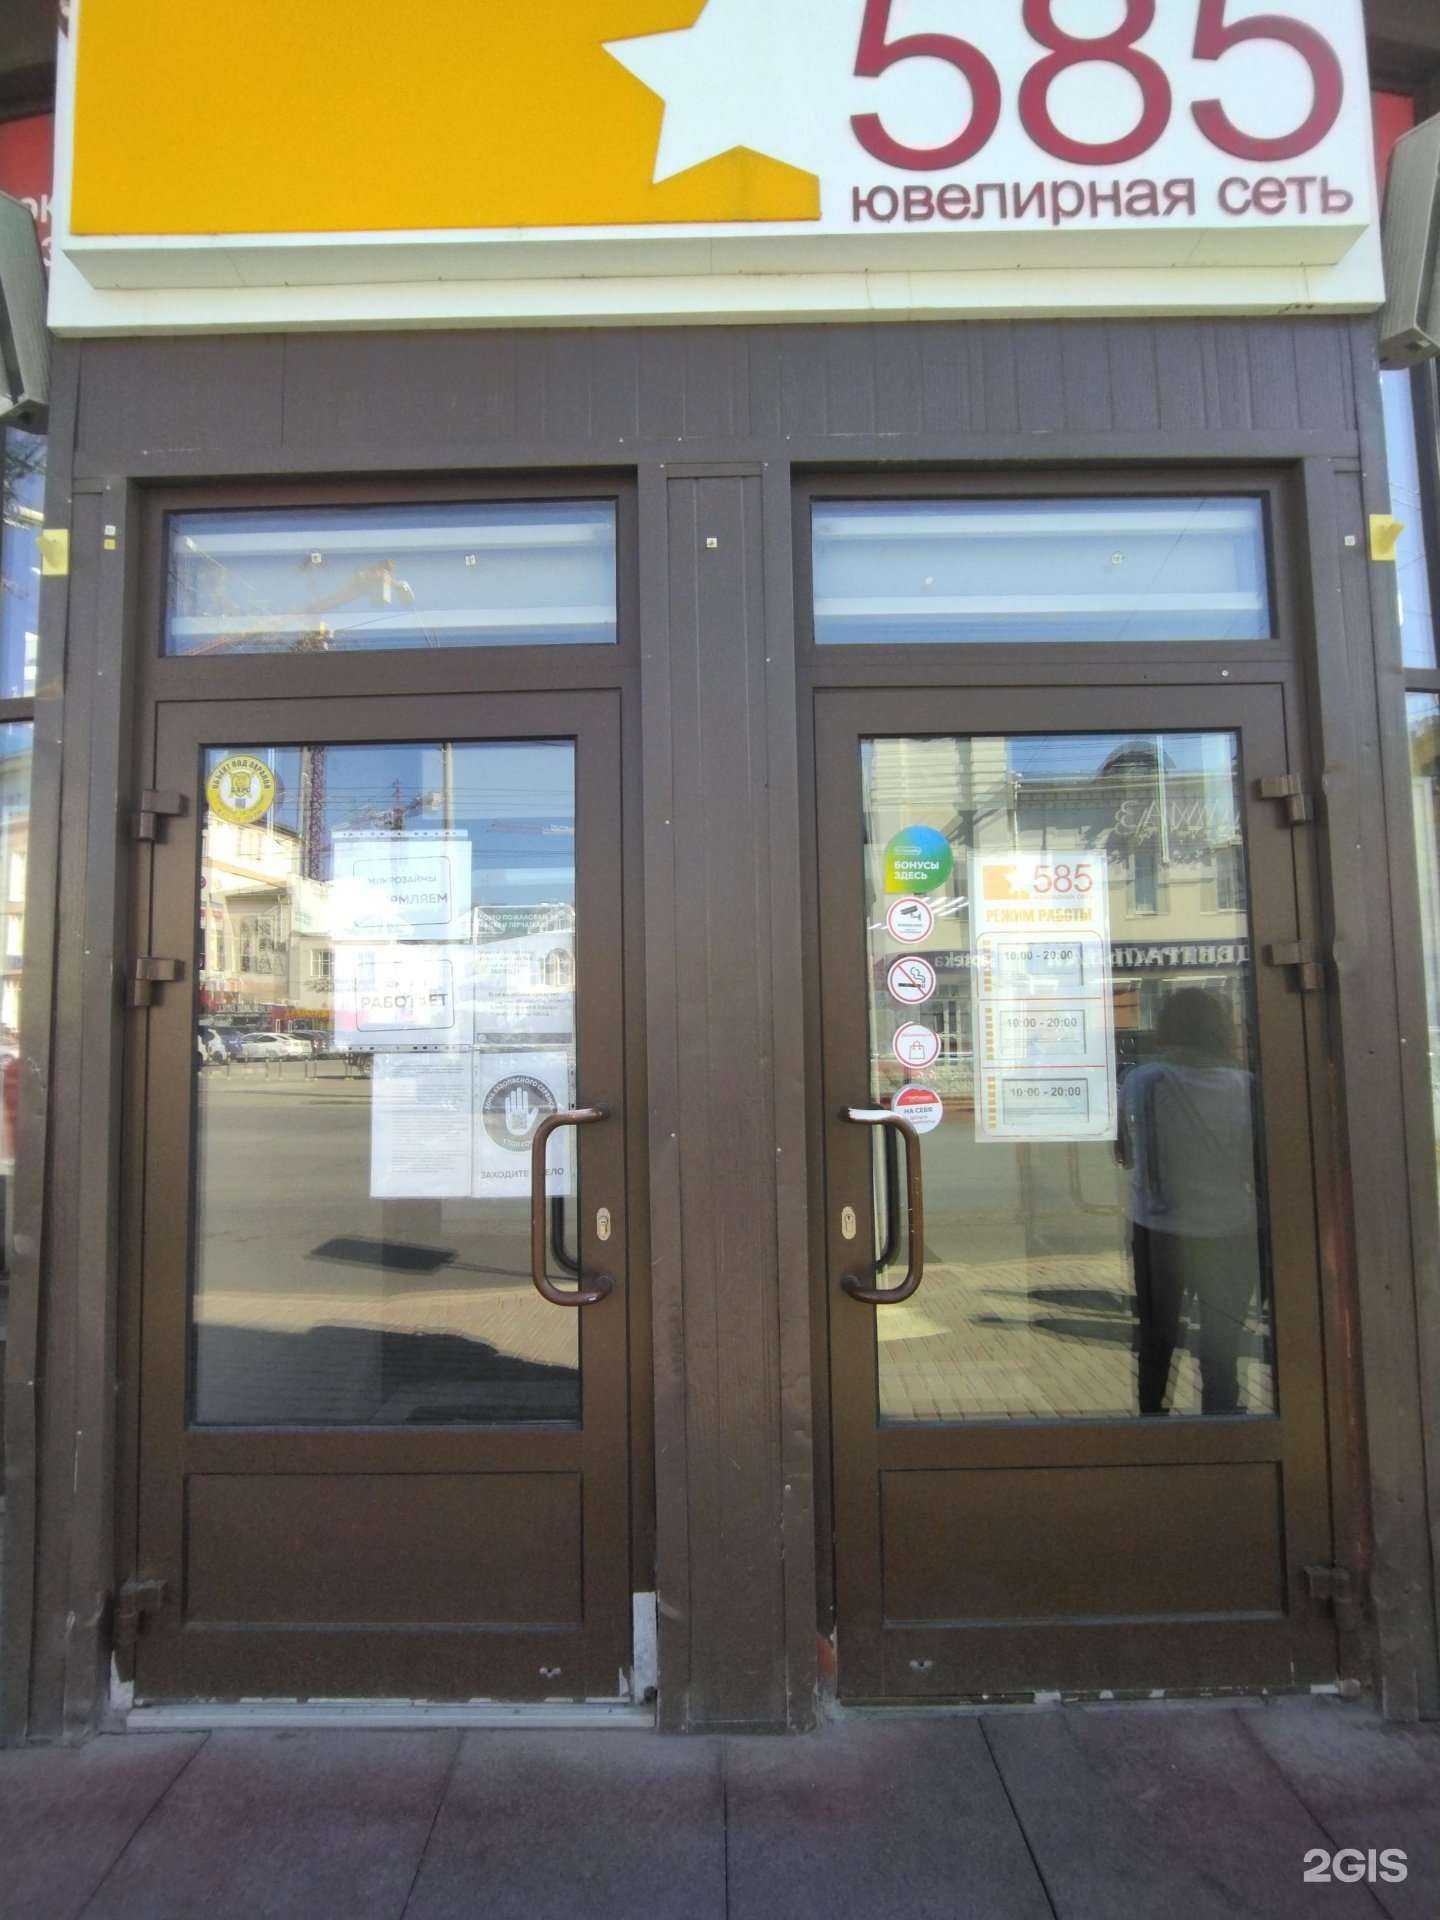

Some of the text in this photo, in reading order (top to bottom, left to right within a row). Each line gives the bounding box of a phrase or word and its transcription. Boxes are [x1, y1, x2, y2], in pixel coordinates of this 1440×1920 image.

[850, 0, 1344, 171] 585
[852, 176, 1354, 225] ювелирная сеть
[894, 861, 940, 870] БОНУСЫ
[894, 872, 928, 880] ЗДЕСЬ
[1033, 864, 1093, 893] 585
[986, 908, 1092, 922] РЕЖИМ РАБОТЫ
[1007, 1018, 1036, 1028] 10:00
[1047, 1018, 1077, 1028] 20:00
[1010, 1088, 1040, 1097] 10:00
[1051, 1087, 1081, 1097] 20:00
[481, 1169, 528, 1179] ЗАХОДИТЕ
